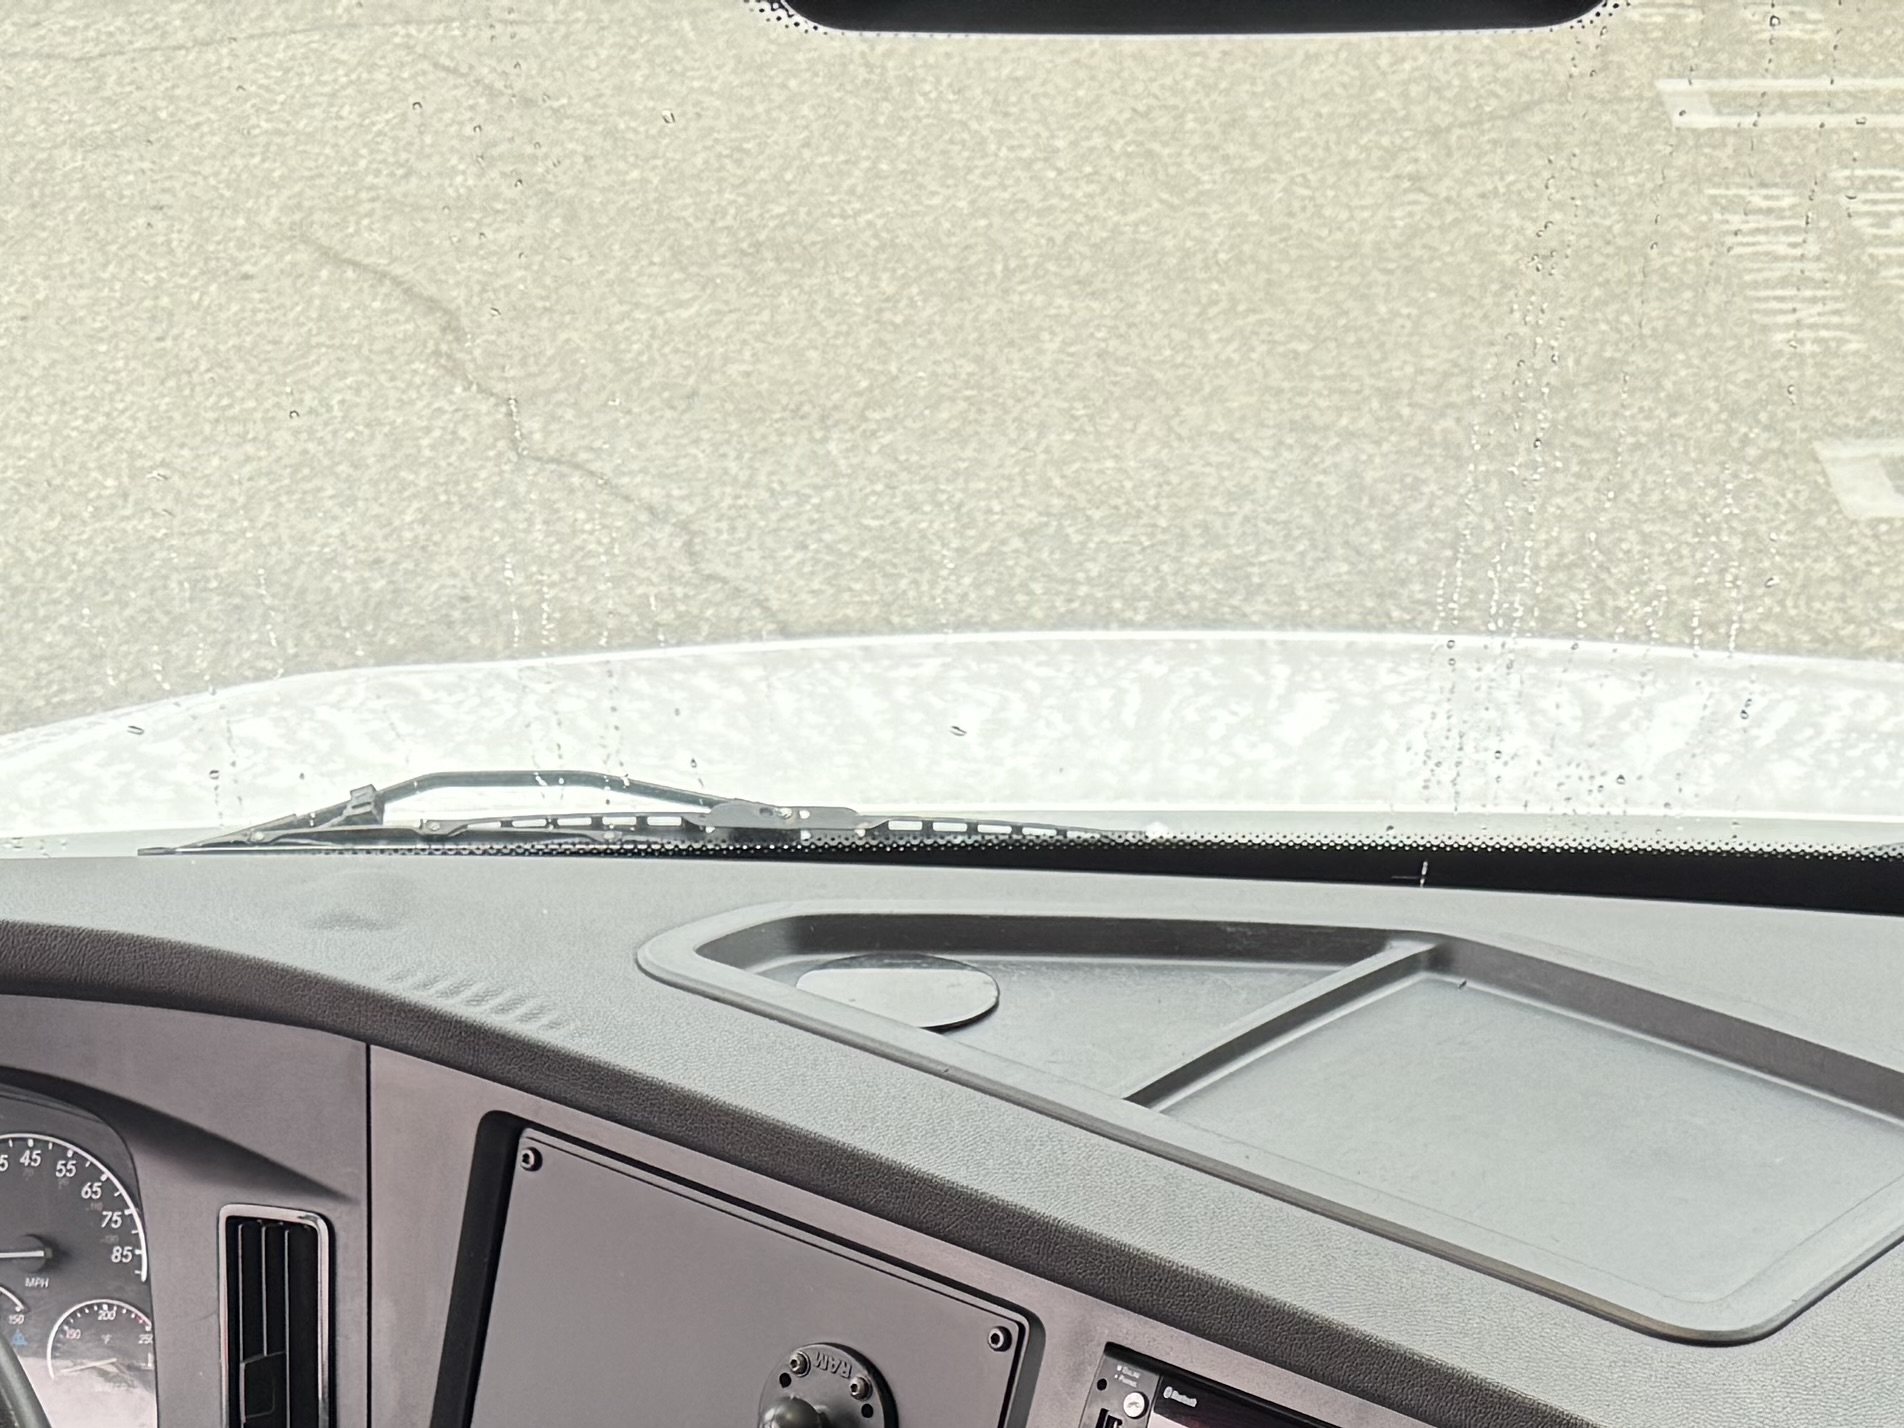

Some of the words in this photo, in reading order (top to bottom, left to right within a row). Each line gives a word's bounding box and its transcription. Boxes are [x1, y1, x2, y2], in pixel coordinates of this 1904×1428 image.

[20, 1150, 41, 1166] 45
[55, 1160, 76, 1177] 55
[81, 1182, 102, 1199] 65
[101, 1212, 122, 1228] 75
[111, 1246, 133, 1263] 85
[25, 1278, 49, 1288] MPH
[8, 1315, 24, 1324] 150
[98, 1310, 116, 1320] 200
[814, 1352, 852, 1379] RAM
